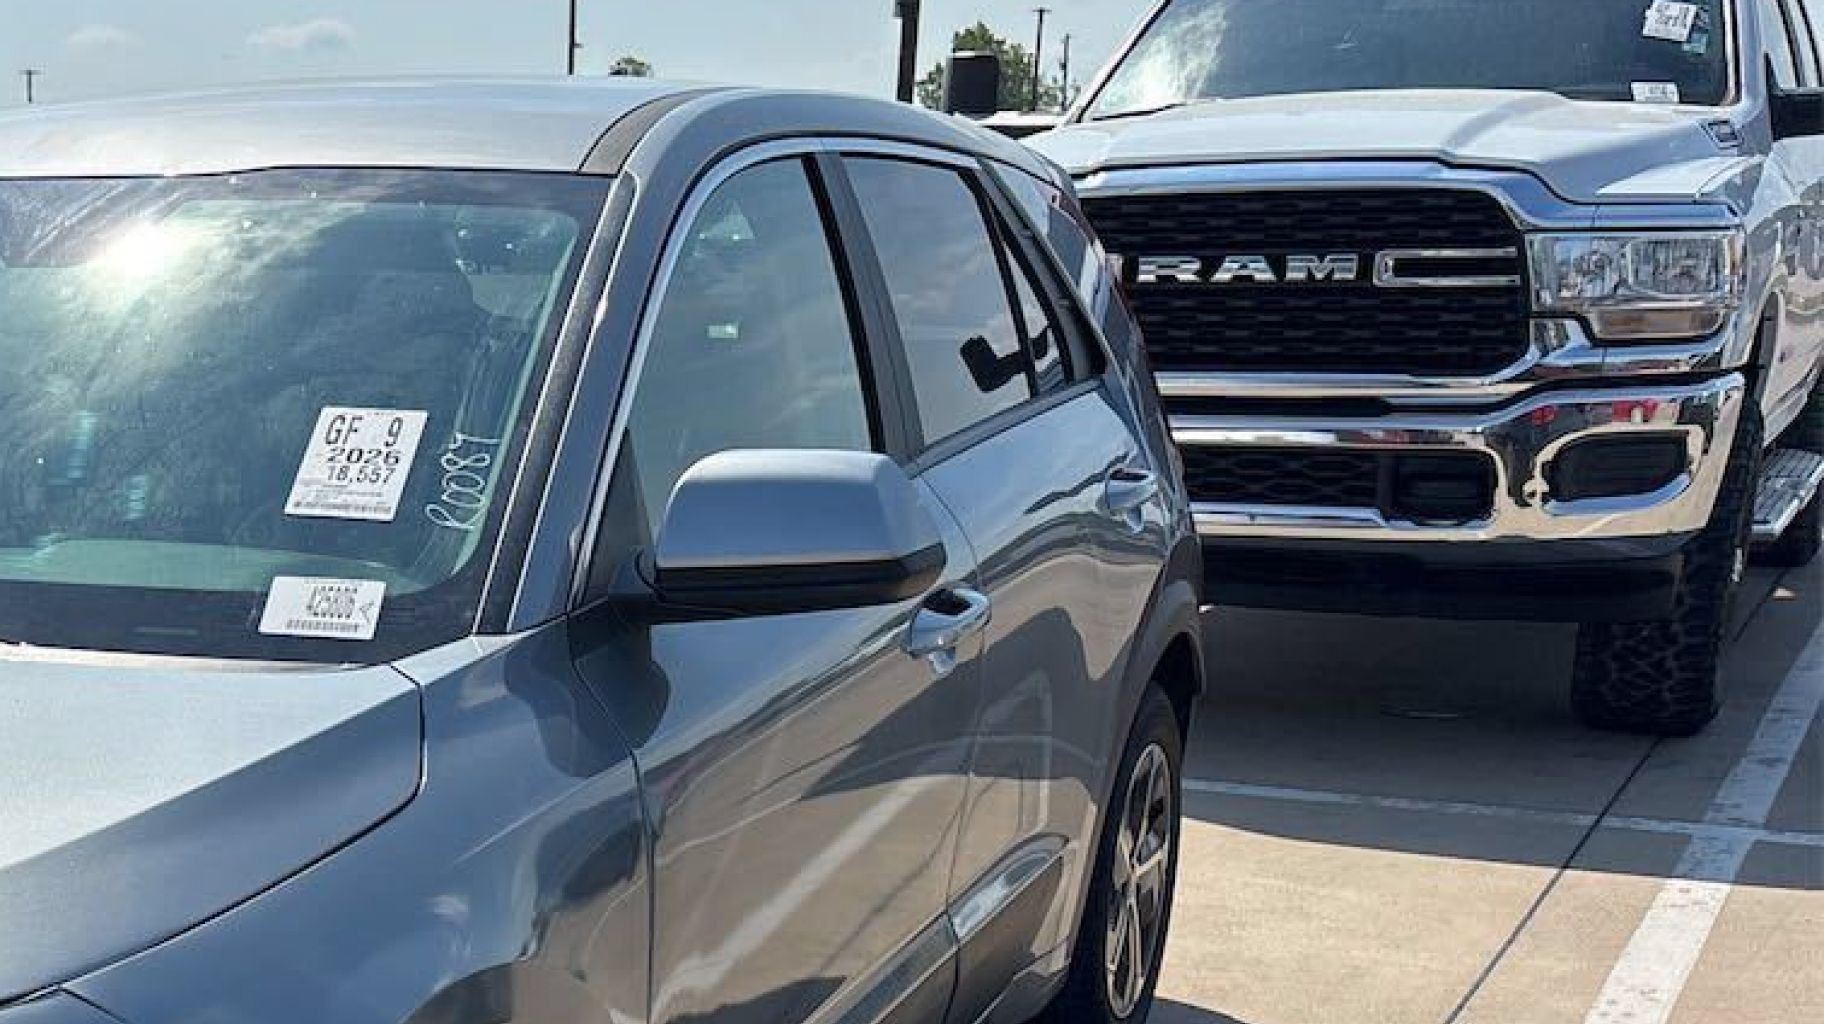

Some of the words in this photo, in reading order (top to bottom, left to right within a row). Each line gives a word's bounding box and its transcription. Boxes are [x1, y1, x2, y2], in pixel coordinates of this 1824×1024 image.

[1136, 254, 1358, 283] RAM
[325, 414, 364, 445] GF
[384, 416, 404, 447] 9
[327, 447, 402, 466] 2026
